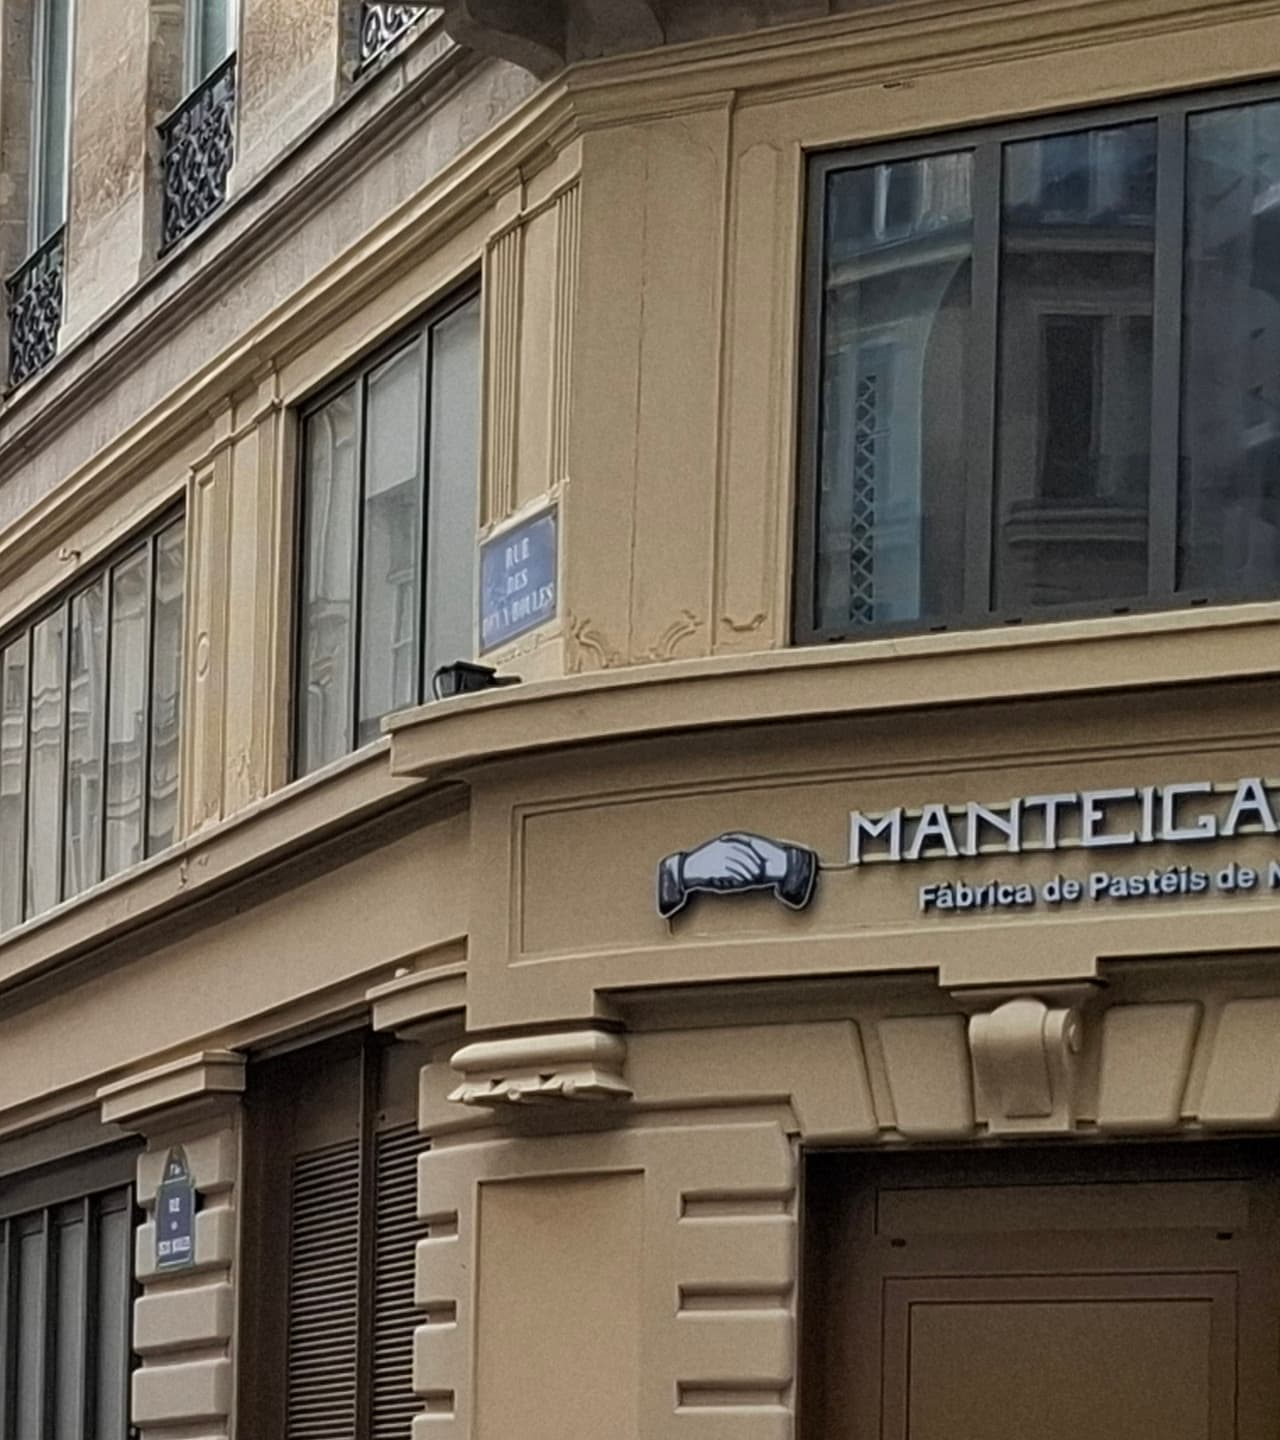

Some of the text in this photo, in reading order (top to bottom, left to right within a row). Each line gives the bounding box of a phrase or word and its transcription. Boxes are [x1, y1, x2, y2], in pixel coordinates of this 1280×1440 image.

[505, 537, 530, 569] RUE
[849, 778, 1280, 863] MANTEIGA
[918, 879, 1034, 911] Fábrica
[1042, 874, 1081, 902] de
[1088, 864, 1208, 899] Pastéis
[1216, 862, 1256, 889] de
